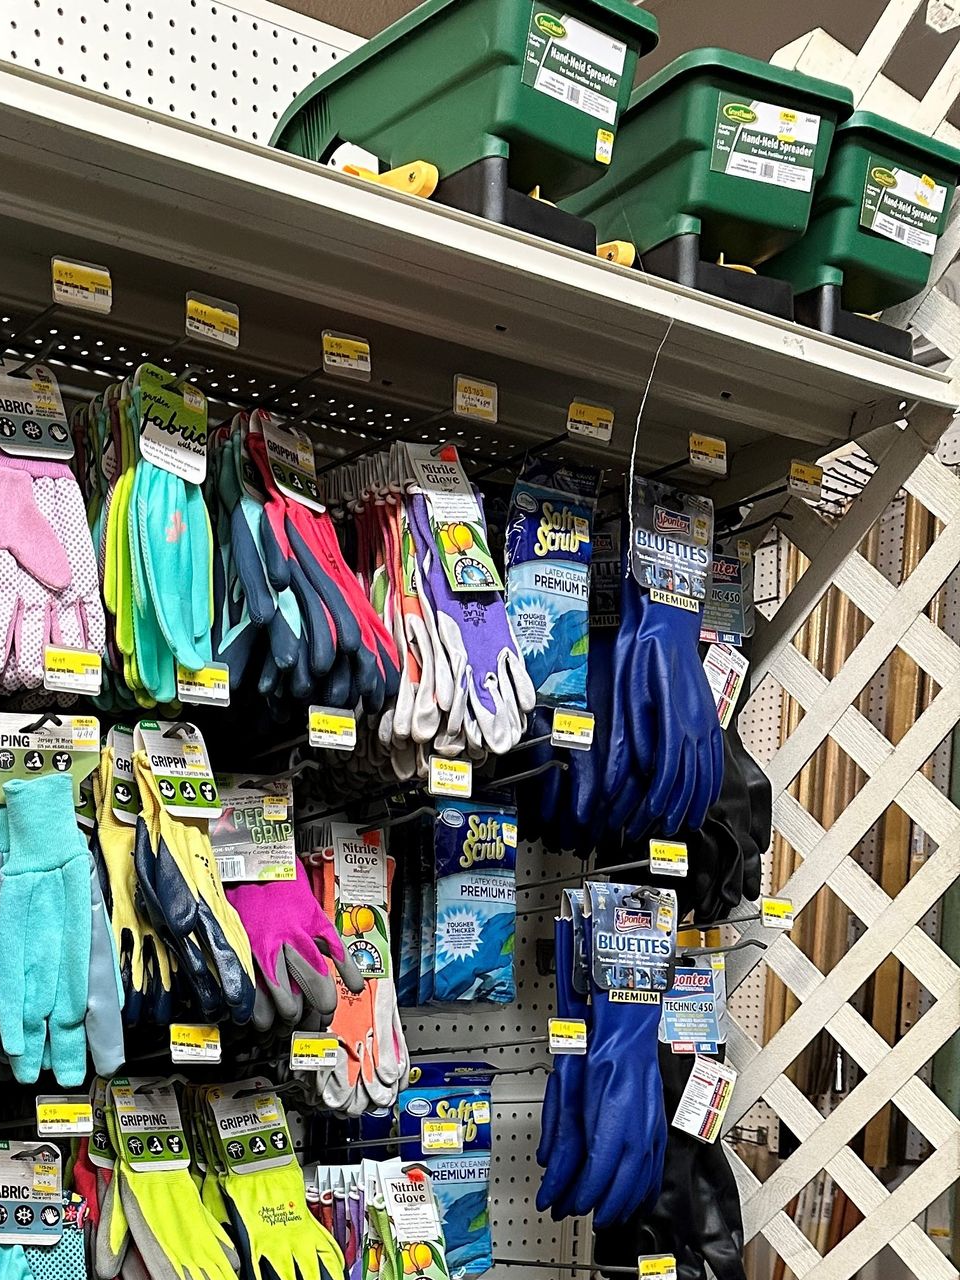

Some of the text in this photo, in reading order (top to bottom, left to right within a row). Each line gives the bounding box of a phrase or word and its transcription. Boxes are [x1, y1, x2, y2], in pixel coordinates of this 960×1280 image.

[550, 47, 618, 88] Hand-Held Spreader
[741, 131, 813, 158] Hand-Held Spreader
[883, 193, 938, 225] Hand-Held Spreader
[142, 392, 171, 409] garden
[141, 404, 208, 447] fabric
[177, 439, 191, 449] with
[421, 463, 457, 476] Nitrile
[426, 474, 461, 486] Glove
[655, 510, 690, 534] Spontex
[534, 527, 581, 557] Scrub
[636, 530, 709, 565] BLUETTES
[544, 567, 564, 579] LATEX
[534, 574, 580, 595] PREMIUM
[653, 590, 699, 611] PREMIUM
[724, 589, 741, 603] 450
[518, 613, 547, 622] TOUGHER
[251, 823, 293, 845] GRIP
[468, 815, 501, 843] Soft
[343, 842, 378, 855] Nitrile
[459, 837, 506, 868] Scrub
[344, 854, 378, 867] Glove
[471, 877, 490, 885] LATEX
[460, 884, 506, 899] PREMIUM
[616, 911, 652, 929] Spontex
[598, 935, 671, 955] BLUETTES
[611, 990, 659, 1003] PREMIUM
[665, 1001, 714, 1013] TECHNIC 450
[120, 1114, 167, 1128] GRIPPING
[437, 1162, 456, 1170] LATEX
[391, 1181, 425, 1192] Nitrile
[394, 1192, 426, 1203] Glove
